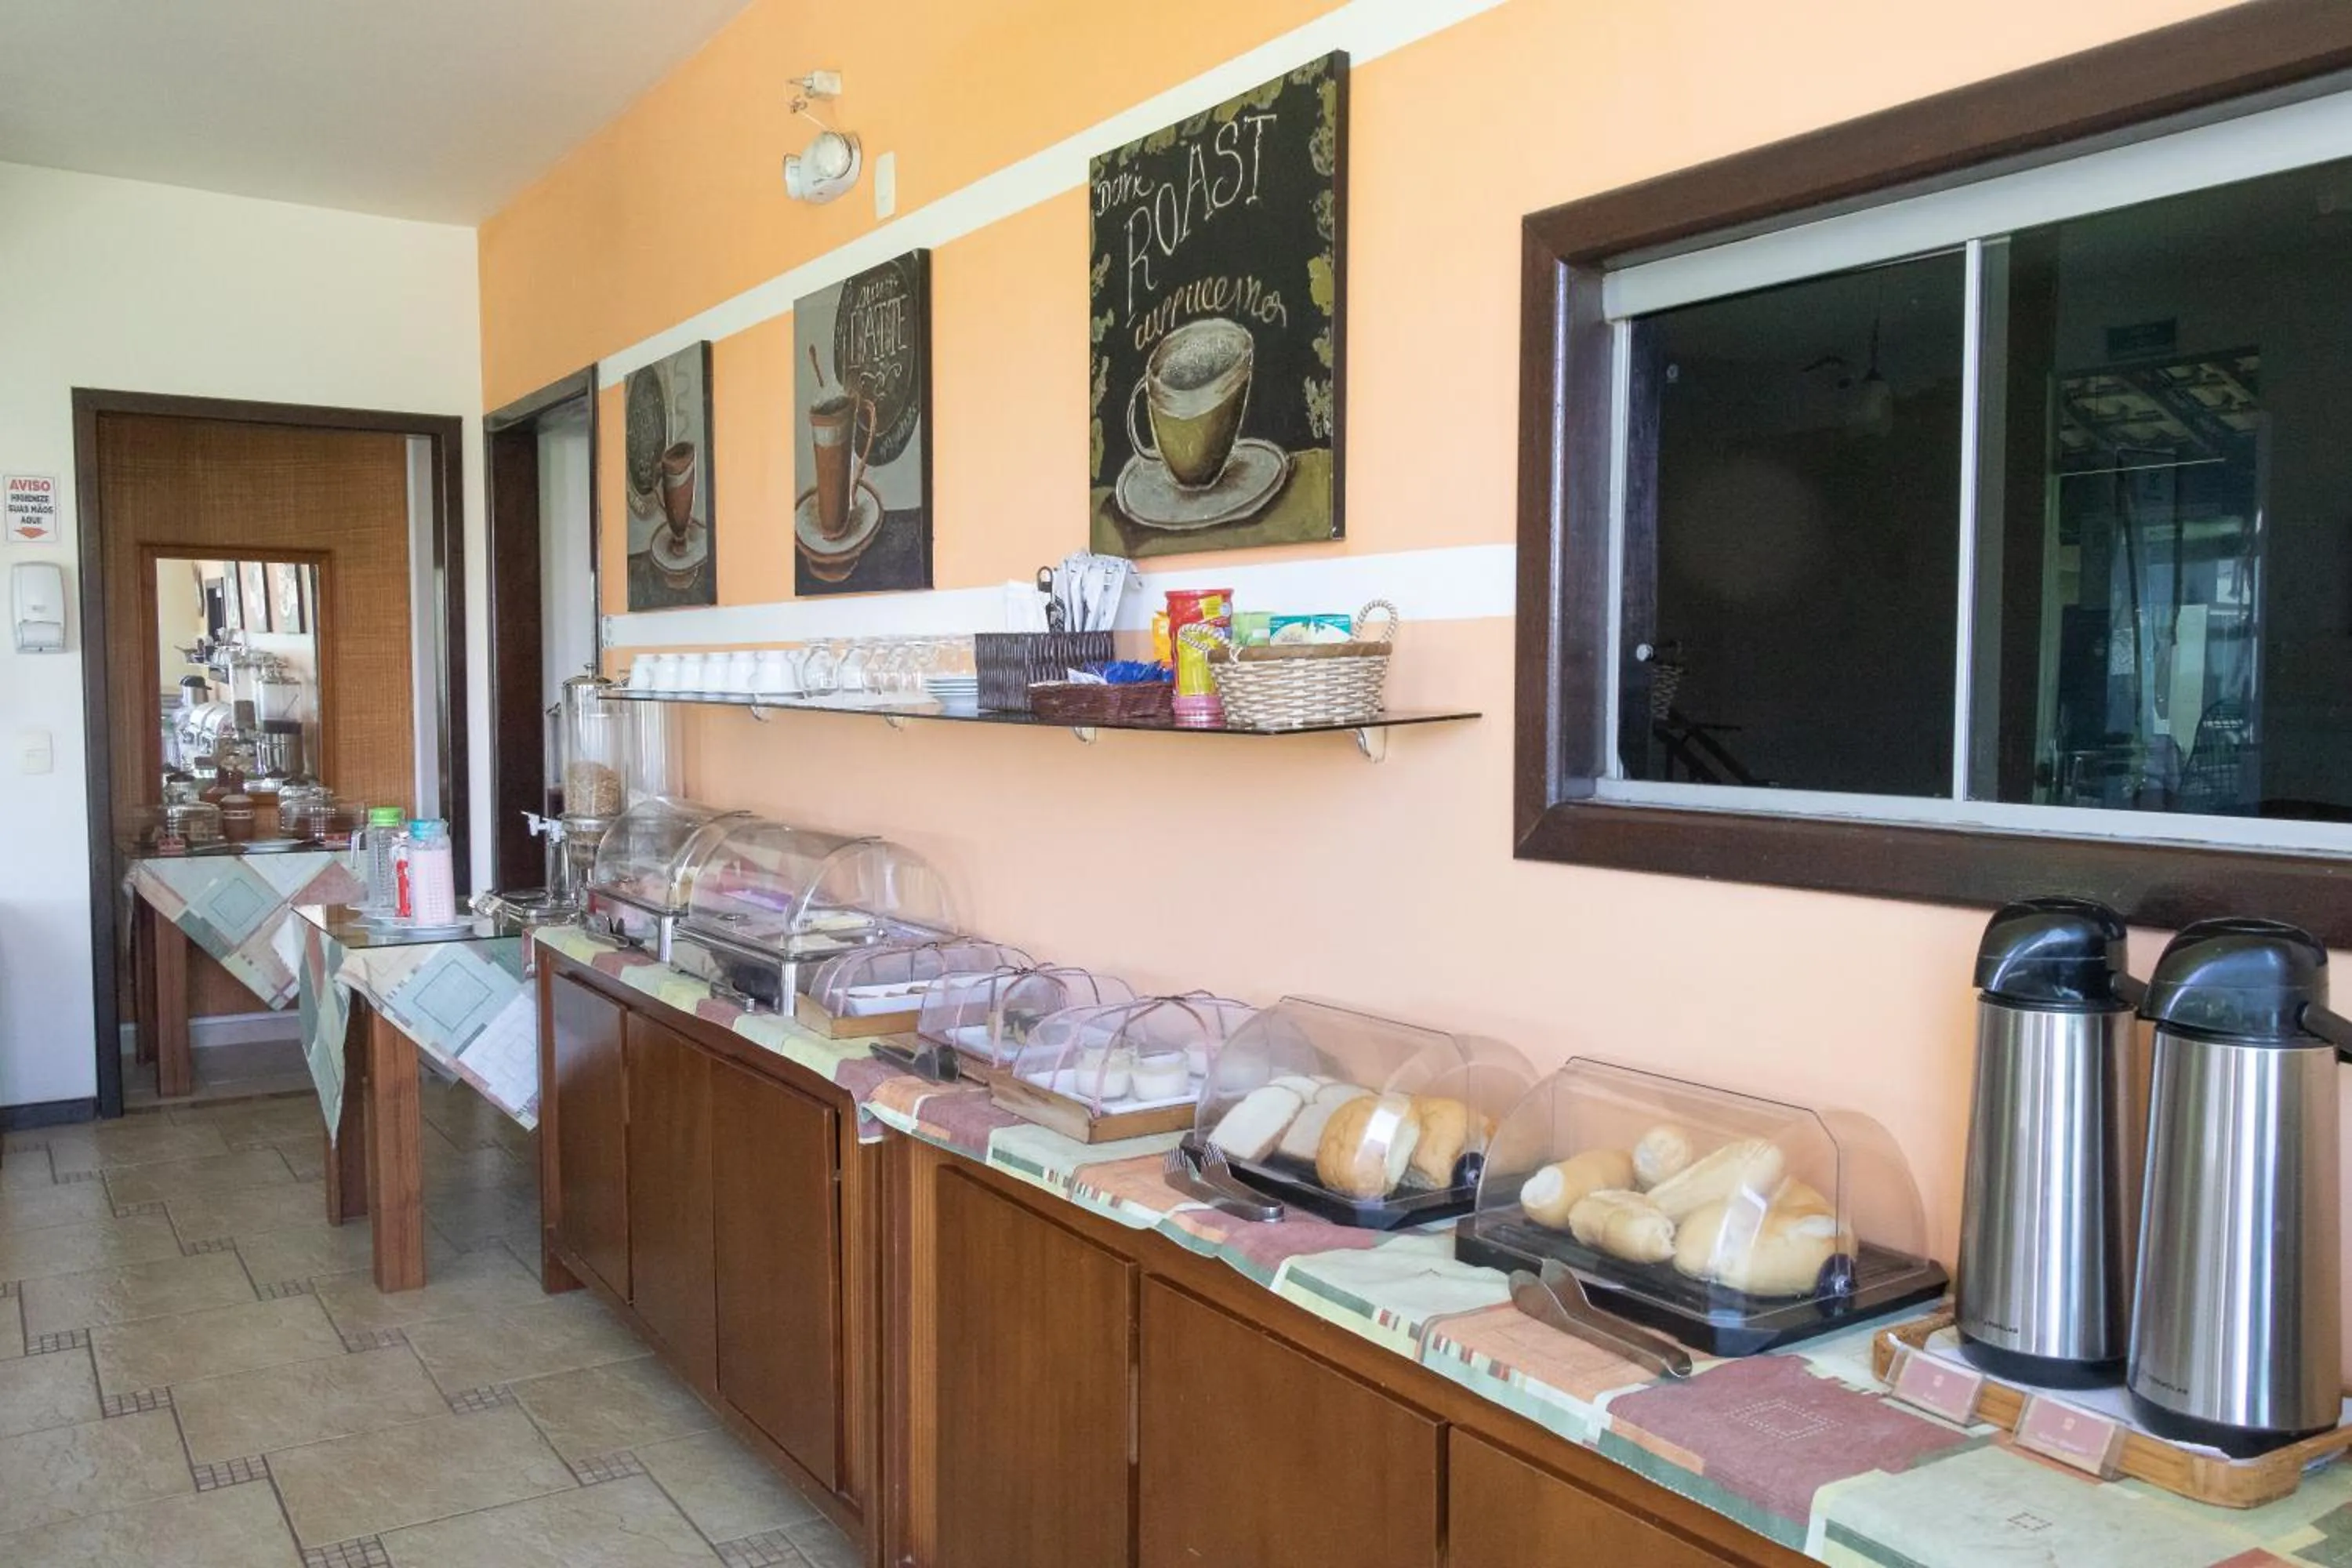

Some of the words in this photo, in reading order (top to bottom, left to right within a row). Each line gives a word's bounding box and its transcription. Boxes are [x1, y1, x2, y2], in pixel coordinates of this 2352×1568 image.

[1124, 114, 1278, 328] ROAST
[9, 479, 51, 492] AVISO
[8, 504, 29, 514] SUAS
